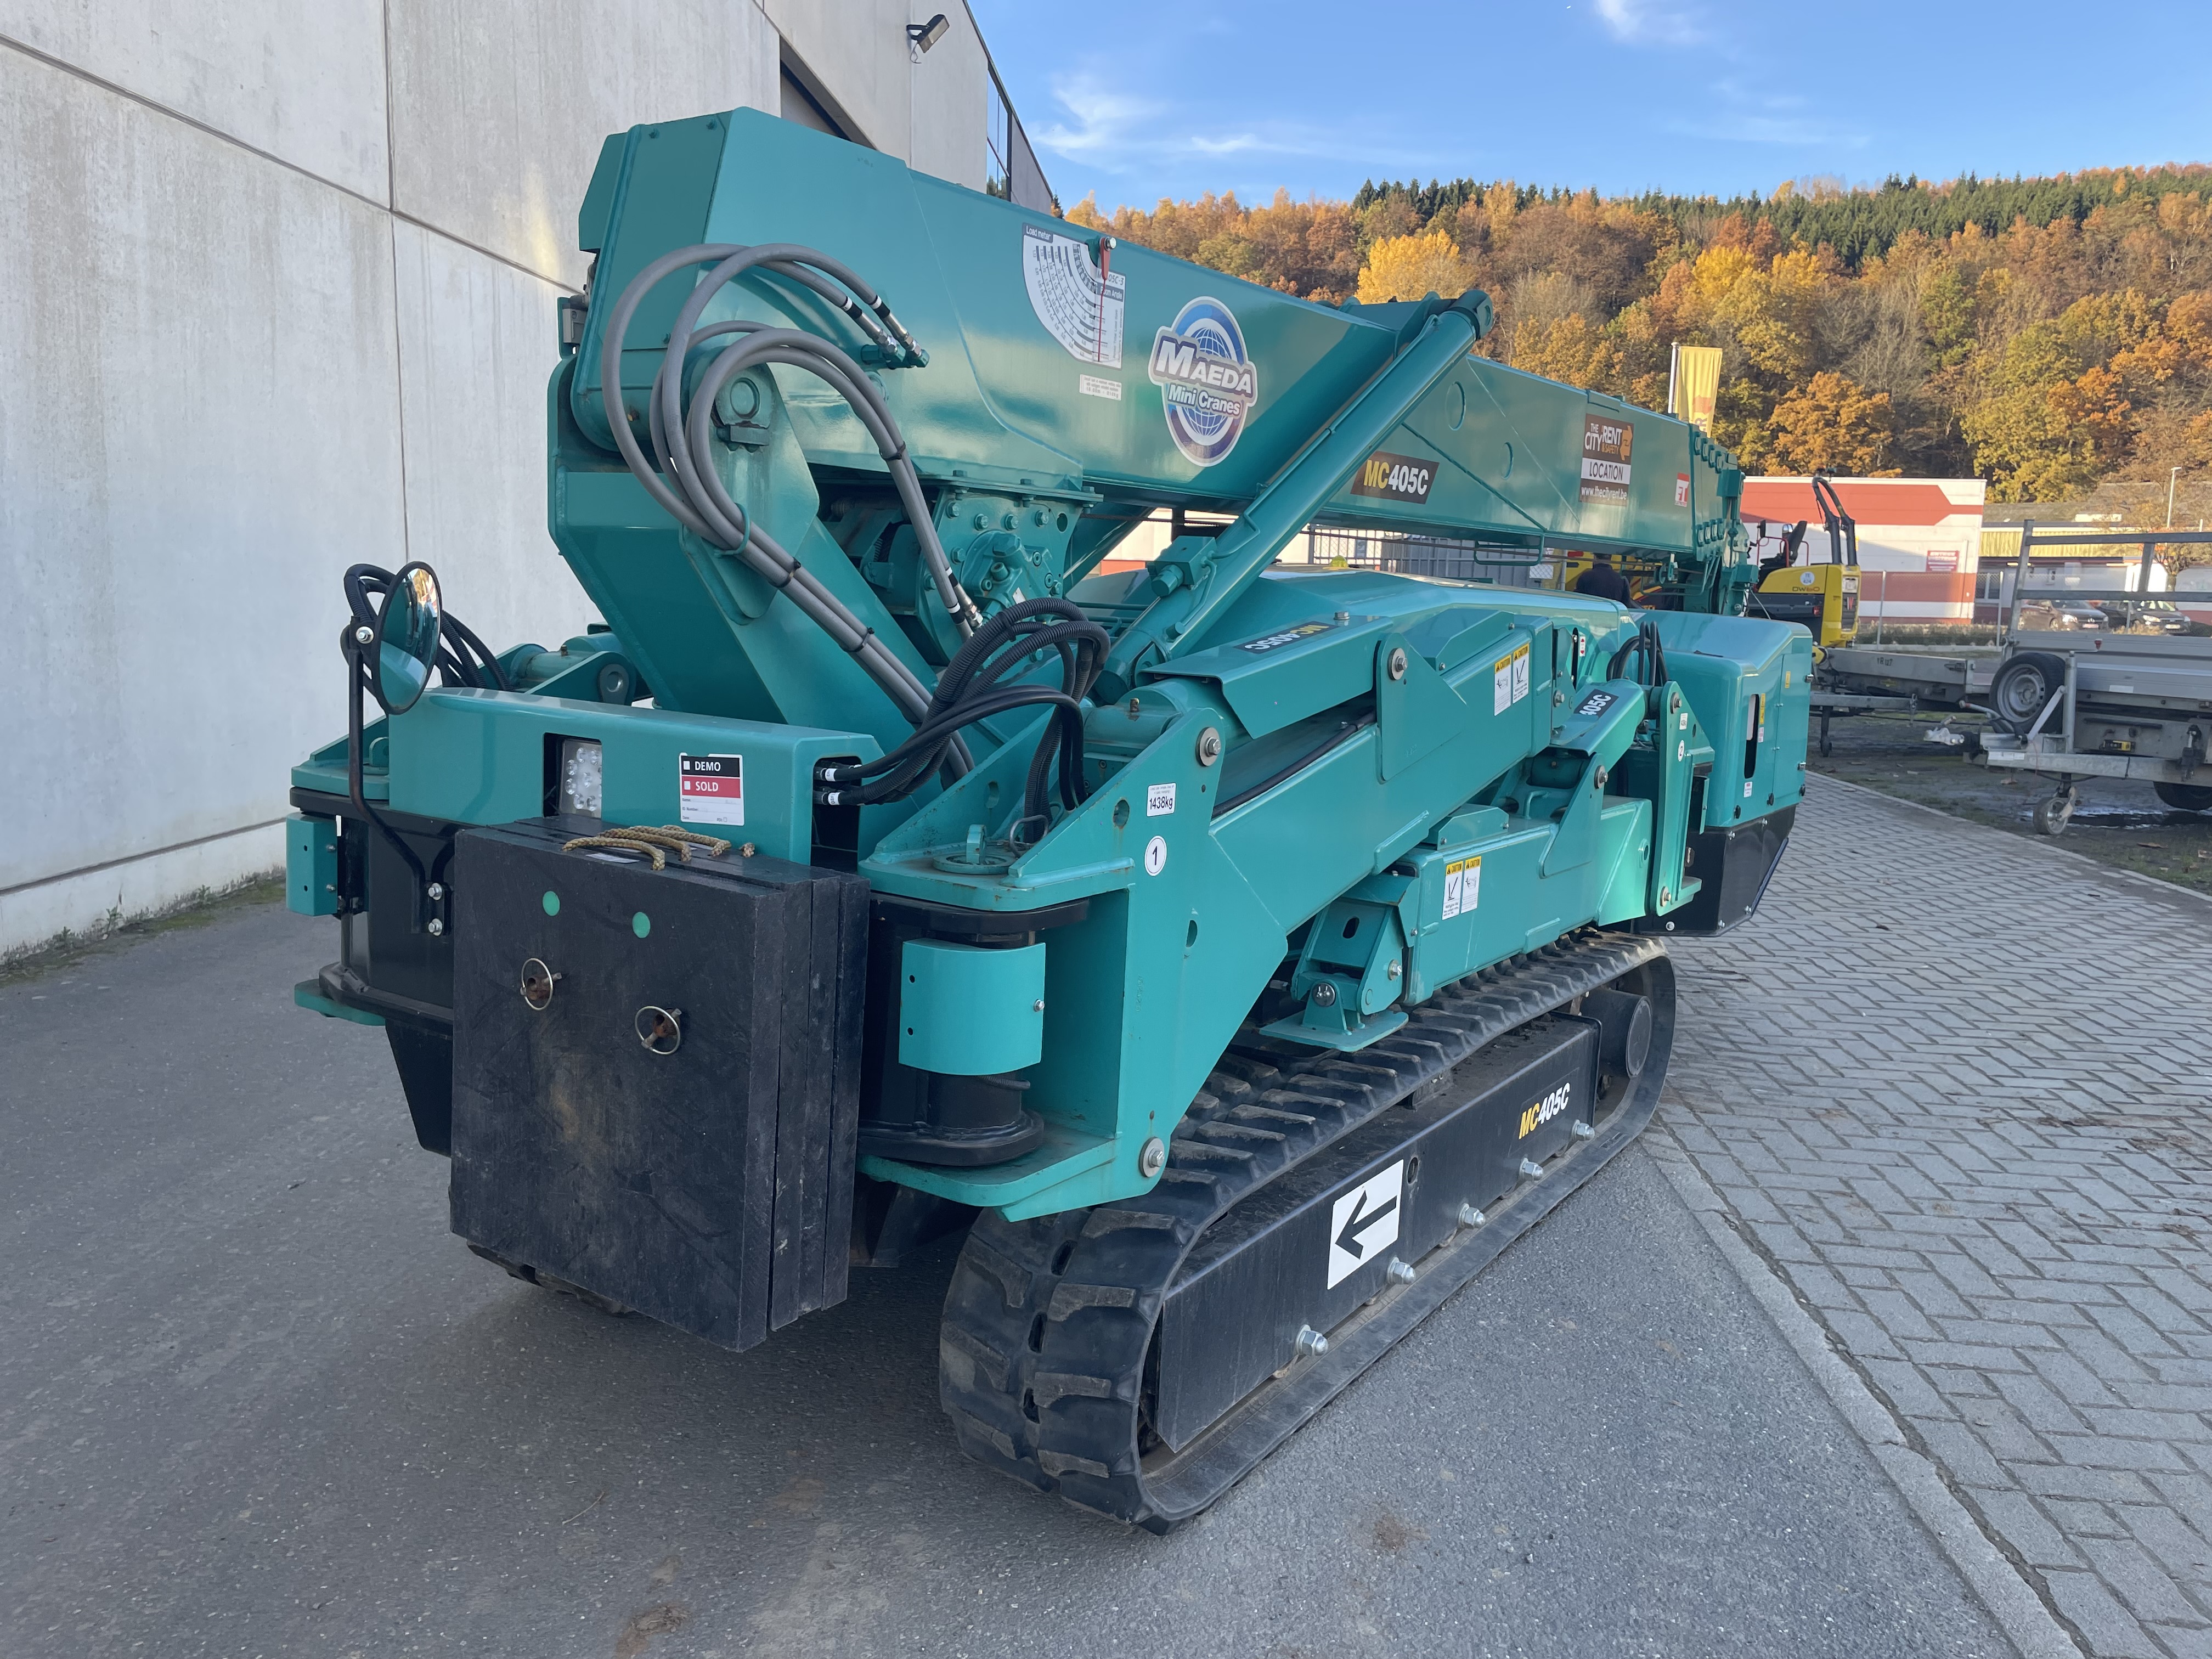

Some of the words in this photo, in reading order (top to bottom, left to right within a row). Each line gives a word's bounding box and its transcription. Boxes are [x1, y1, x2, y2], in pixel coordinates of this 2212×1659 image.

[1026, 225, 1037, 236] Load
[1037, 230, 1051, 240] meter
[1101, 286, 1111, 296] Bom
[1155, 340, 1252, 394] MAEDA
[1168, 384, 1197, 405] Mini
[1198, 391, 1241, 415] Cranes
[1584, 431, 1602, 451] CITY
[1602, 425, 1622, 445] RENT
[1591, 423, 1599, 433] THE
[1363, 459, 1429, 495] MC405C
[1589, 461, 1623, 481] LOCATION
[1244, 624, 1330, 650] MC405C
[695, 761, 721, 771] DEMO
[695, 781, 719, 792] SOLD
[1149, 795, 1173, 810] 1438kg
[1152, 845, 1158, 866] 1
[1519, 1082, 1570, 1139] MC405C
